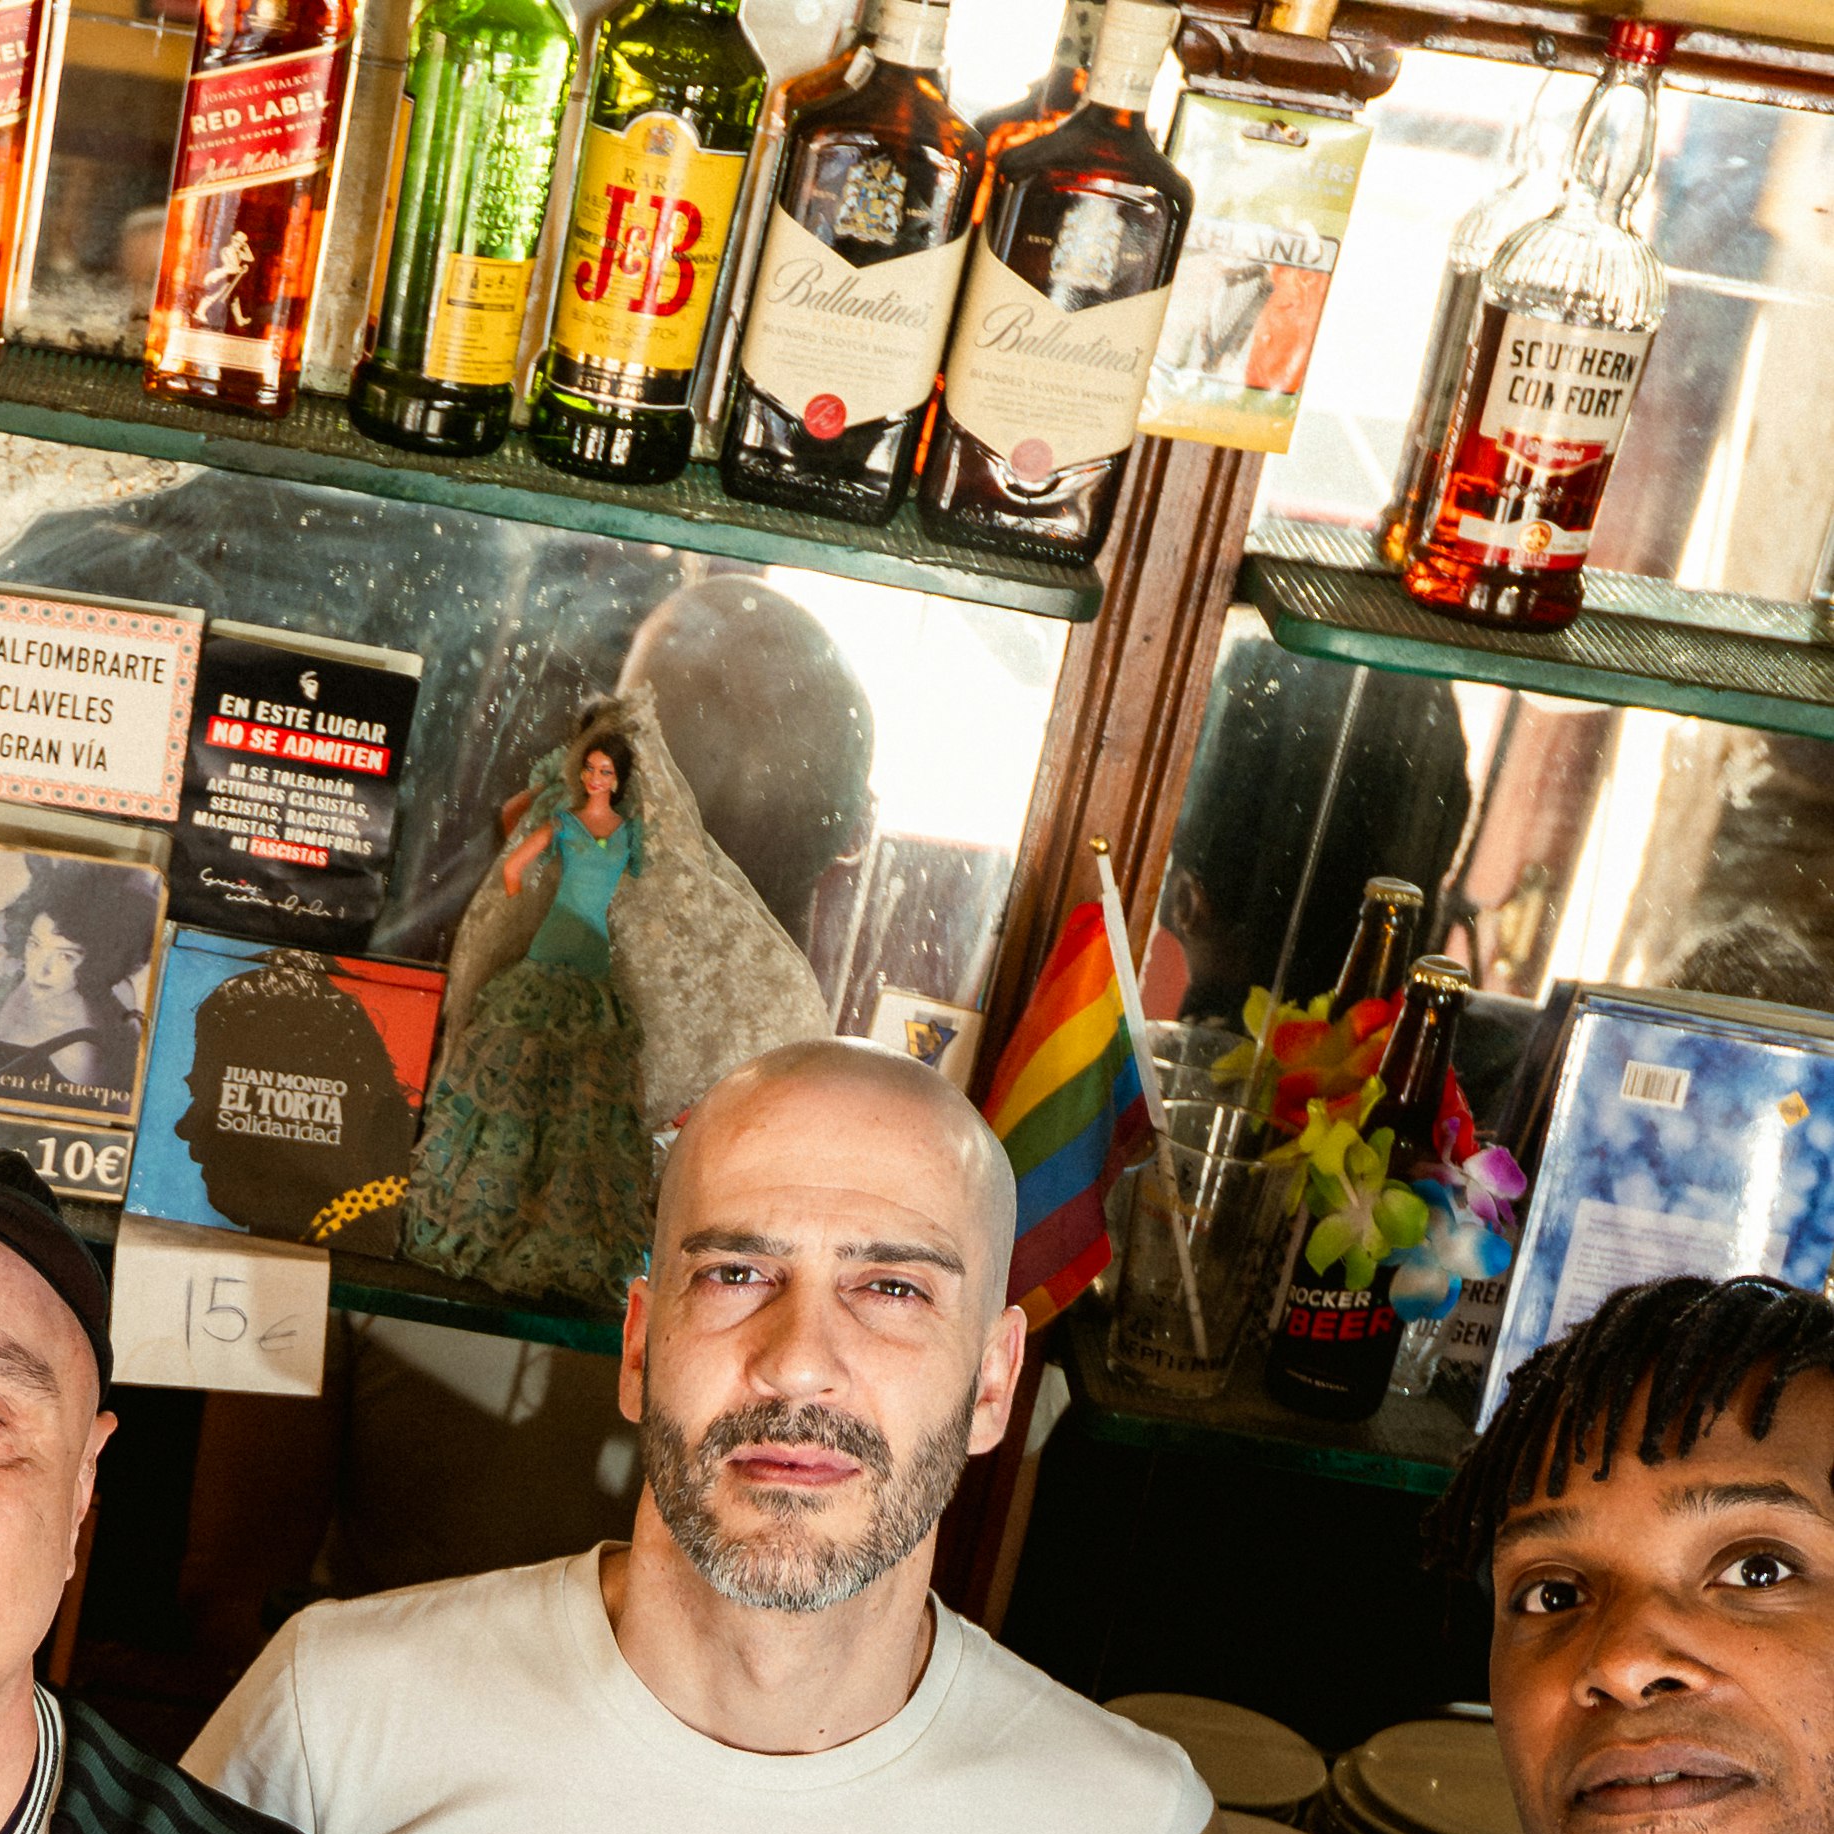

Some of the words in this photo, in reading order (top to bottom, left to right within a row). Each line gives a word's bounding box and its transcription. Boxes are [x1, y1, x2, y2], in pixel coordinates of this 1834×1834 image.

[190, 108, 242, 135] RED
[248, 89, 330, 124] LABEL
[239, 125, 282, 142] SCOTCH
[821, 336, 868, 352] SCOTCH
[219, 693, 250, 720] EN
[254, 700, 312, 730] ESTE
[315, 711, 387, 745] LUGAR
[71, 737, 109, 772] VÍA
[212, 720, 244, 745] NO
[249, 728, 280, 752] SE
[283, 735, 384, 771] ADMITEN
[229, 762, 246, 779] NI
[249, 766, 268, 783] SE
[272, 768, 355, 797] TOLERARÁN
[206, 777, 287, 803] ACTITUDES
[288, 791, 370, 821] CLASISTAS,
[209, 795, 283, 825] SEXISTAS,
[285, 808, 361, 837] RACISTAS,
[192, 810, 280, 840] MACHISTAS,
[284, 825, 373, 857] HOMÓFOBAS
[230, 836, 248, 852] NI
[249, 838, 328, 866] FASCISTAS
[31, 1073, 51, 1092] el
[55, 1080, 132, 1107] cuerpo
[222, 1065, 274, 1087] JUAN
[276, 1072, 349, 1097] MONEO
[219, 1081, 253, 1113] EL
[256, 1086, 344, 1125] TORTA
[217, 1109, 342, 1146] Solidaridad
[35, 1136, 128, 1186] 10€
[1287, 1306, 1397, 1341] BEER
